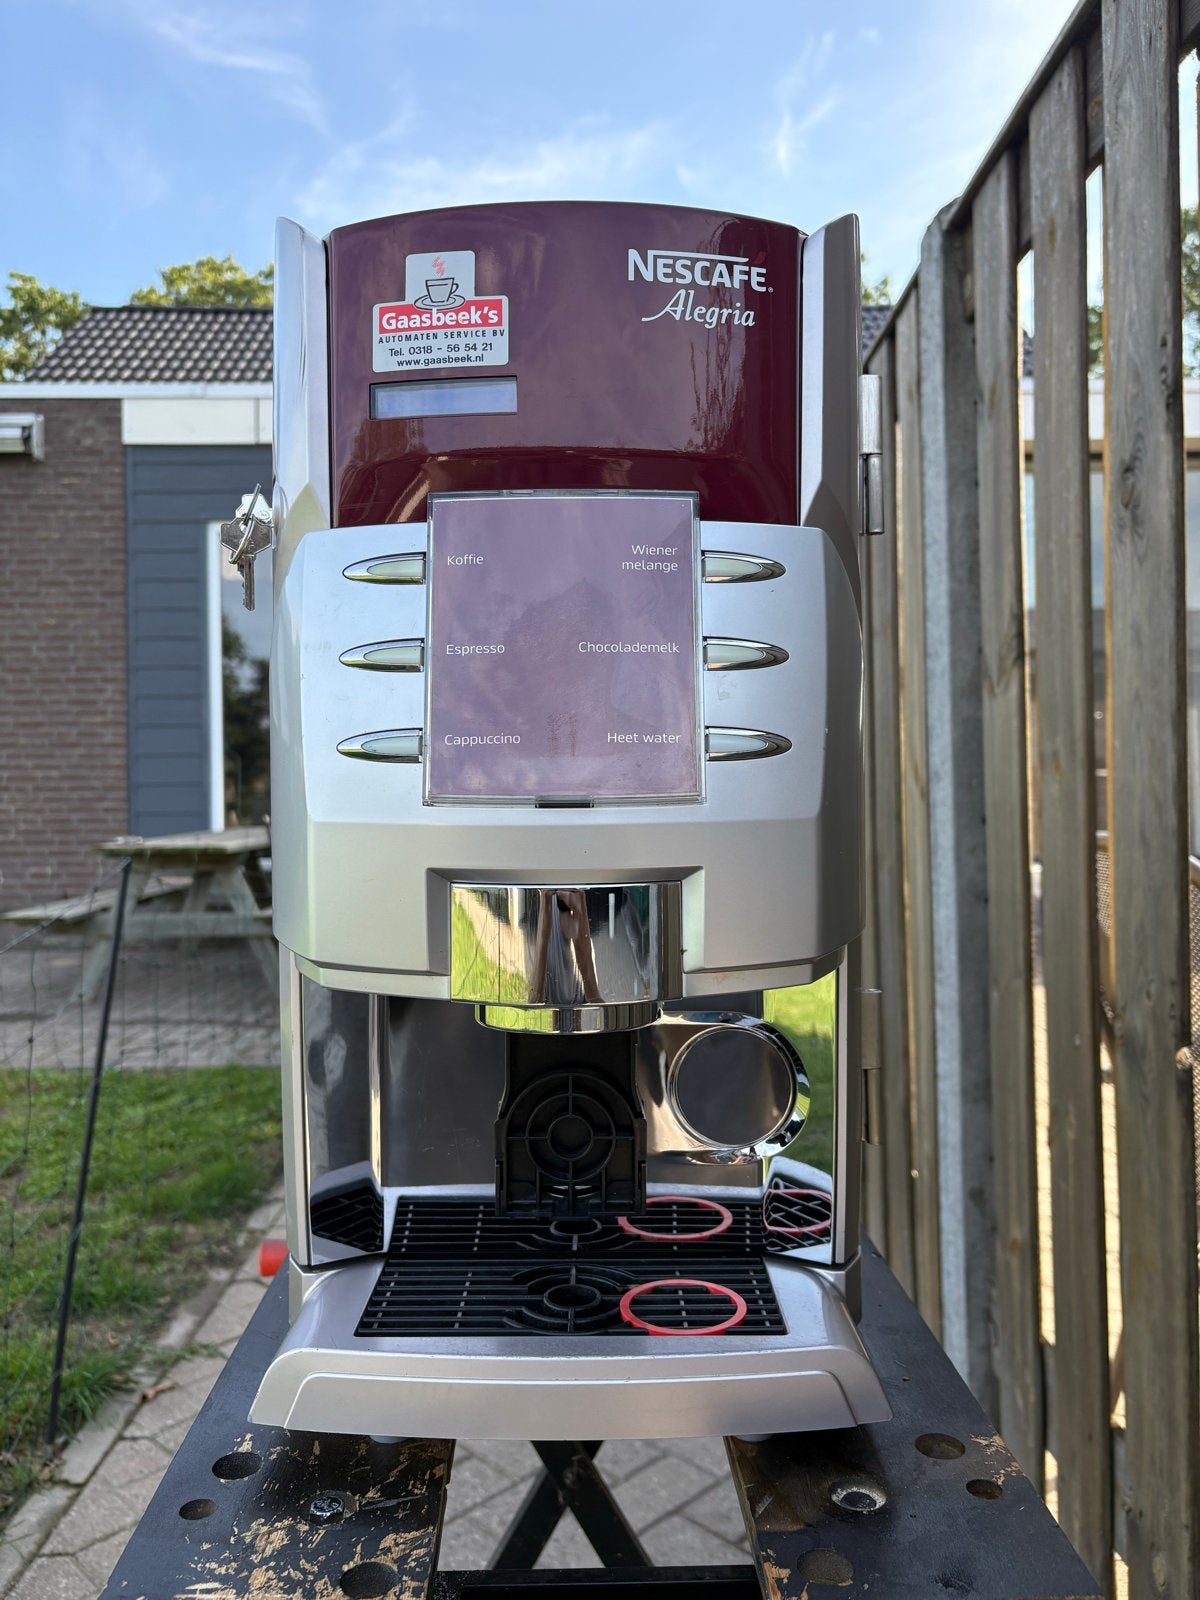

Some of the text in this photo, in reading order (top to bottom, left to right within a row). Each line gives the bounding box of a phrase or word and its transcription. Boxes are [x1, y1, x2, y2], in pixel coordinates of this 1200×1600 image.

[641, 288, 756, 329] Alegria
[382, 307, 498, 330] Gaasbeek's
[378, 328, 505, 344] AUTOMATEN SERVICE BV
[389, 347, 405, 357] Tel.
[408, 345, 433, 356] 0318
[446, 343, 460, 354] 56
[464, 342, 478, 353] 54
[481, 341, 493, 352] 21
[397, 354, 484, 367] www.gaasbeek.nl
[631, 544, 678, 556] Wiener
[446, 554, 484, 566] Koffie
[622, 560, 679, 572] melange
[446, 643, 505, 656] Espresso
[578, 641, 680, 654] Chocolademelk
[444, 732, 521, 746] Cappuccino
[607, 731, 681, 744] Heet water
